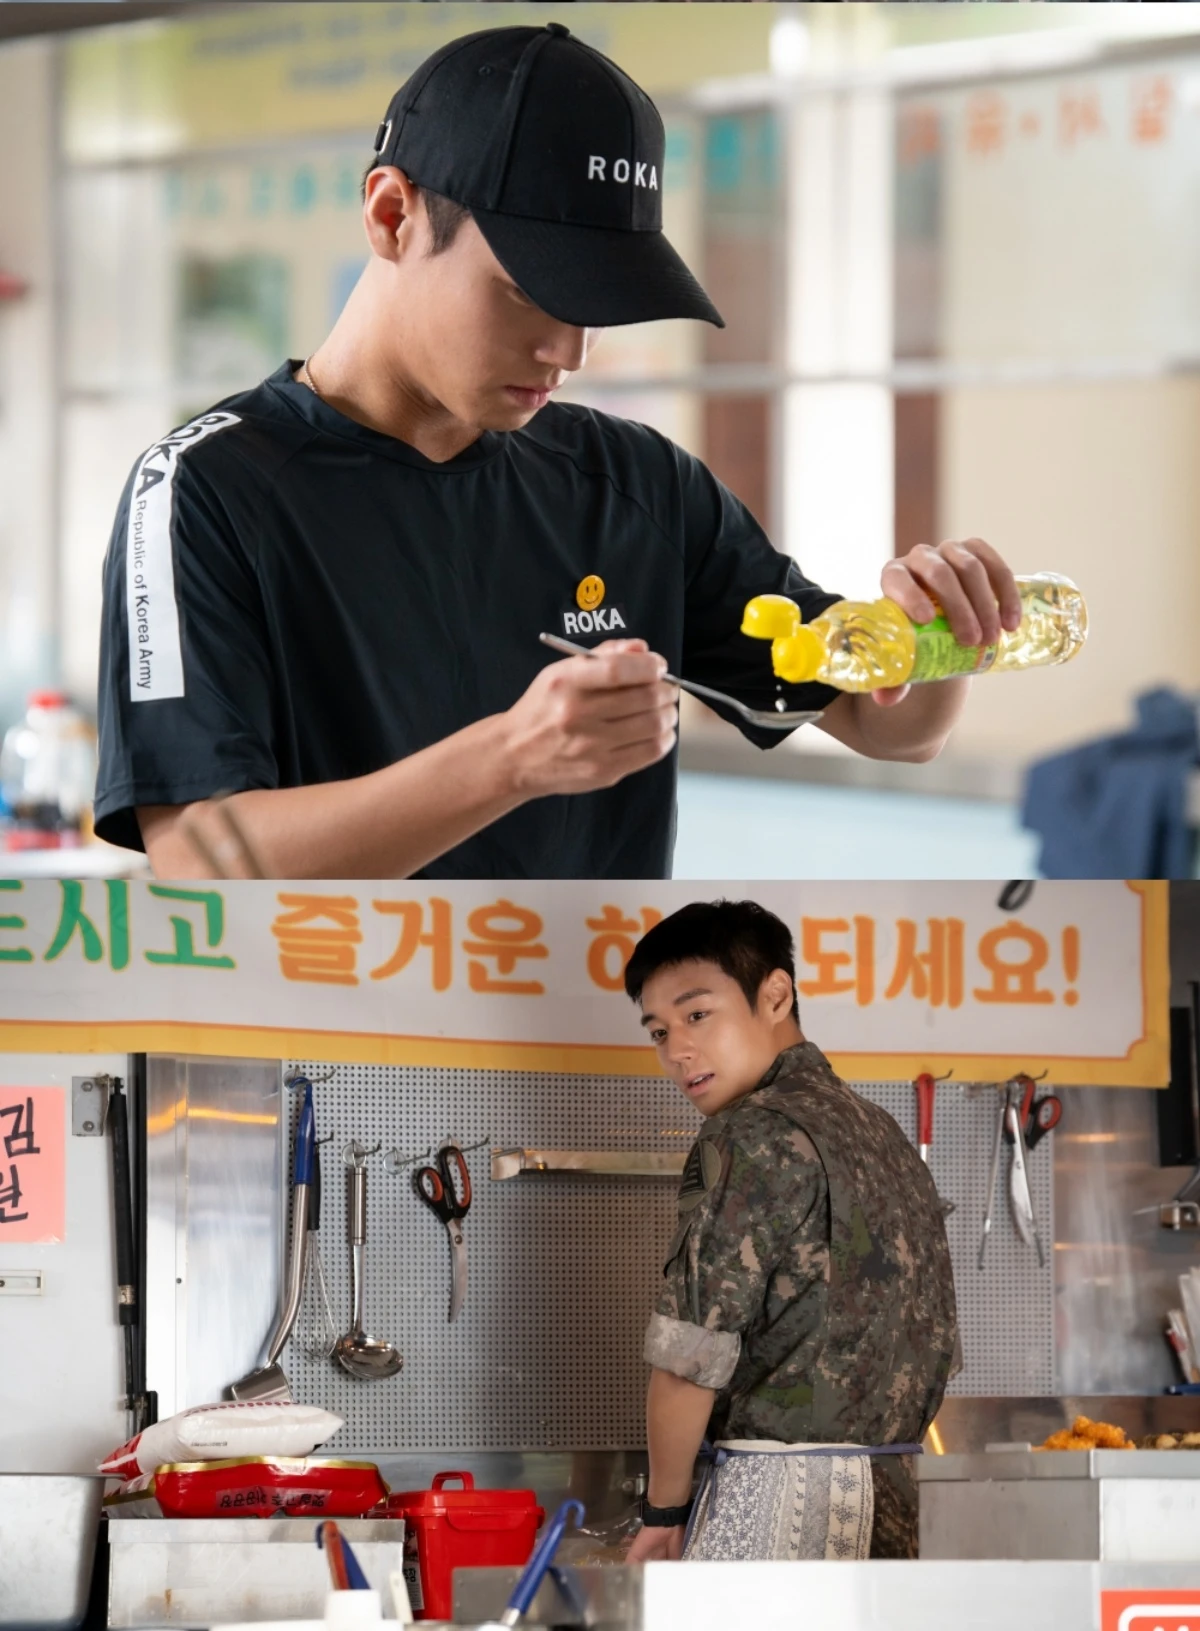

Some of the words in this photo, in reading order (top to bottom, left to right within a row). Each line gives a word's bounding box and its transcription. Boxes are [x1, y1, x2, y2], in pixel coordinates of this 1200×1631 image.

[588, 155, 658, 191] ROKA
[132, 500, 147, 569] Republic
[134, 574, 148, 590] of
[135, 595, 150, 644] Korea
[563, 608, 626, 635] ROKA
[136, 648, 152, 690] Army
[271, 892, 550, 995] 즐거운
[798, 914, 1080, 1010] 되세요!
